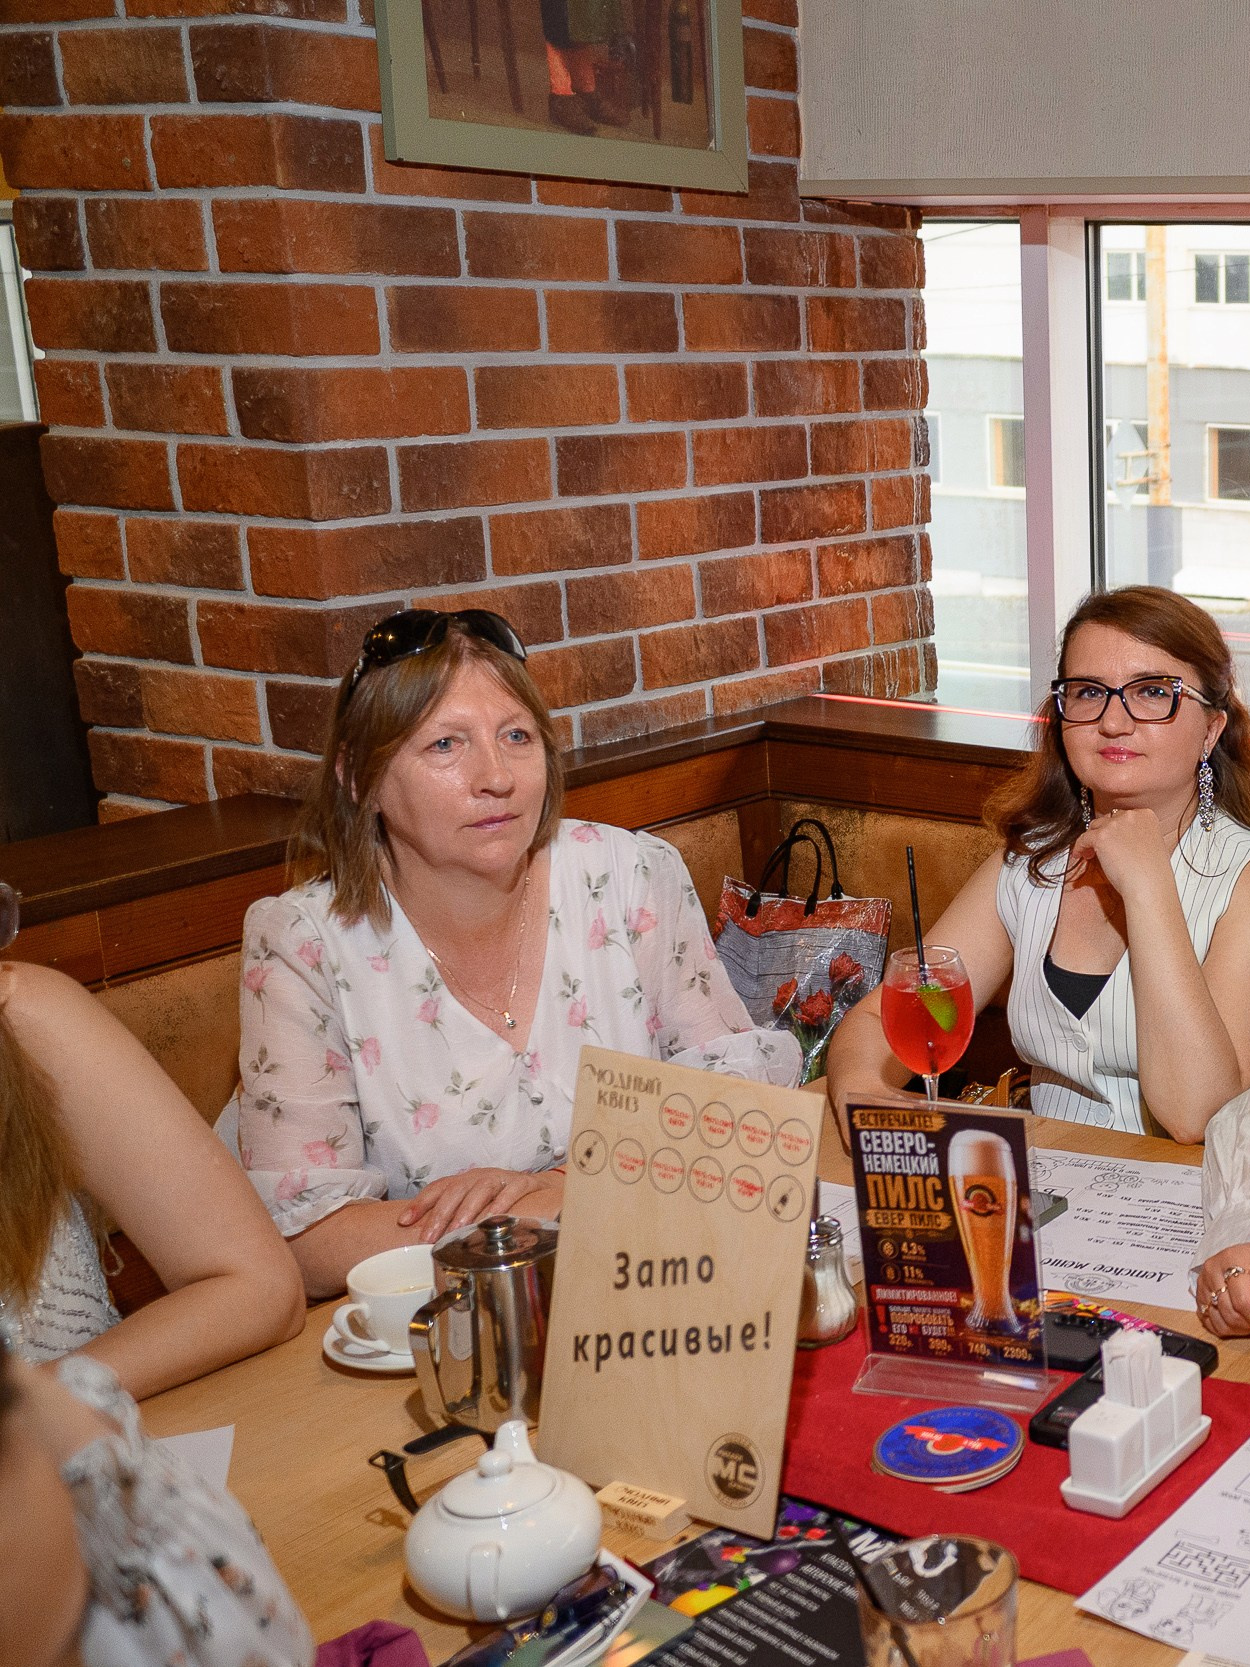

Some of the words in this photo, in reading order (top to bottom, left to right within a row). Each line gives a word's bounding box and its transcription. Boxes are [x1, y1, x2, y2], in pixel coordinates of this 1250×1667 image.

[596, 1089, 639, 1113] КВИЗ
[858, 1112, 934, 1129] ВСТРЕЧАЙТЕ!
[859, 1130, 936, 1155] СЕВЕРО-
[862, 1153, 940, 1176] НЕМЕЦКИЙ
[865, 1175, 945, 1211] ПИЛС
[909, 1214, 943, 1228] ПИЛС
[613, 1251, 715, 1291] Зато
[572, 1311, 771, 1374] красивые!
